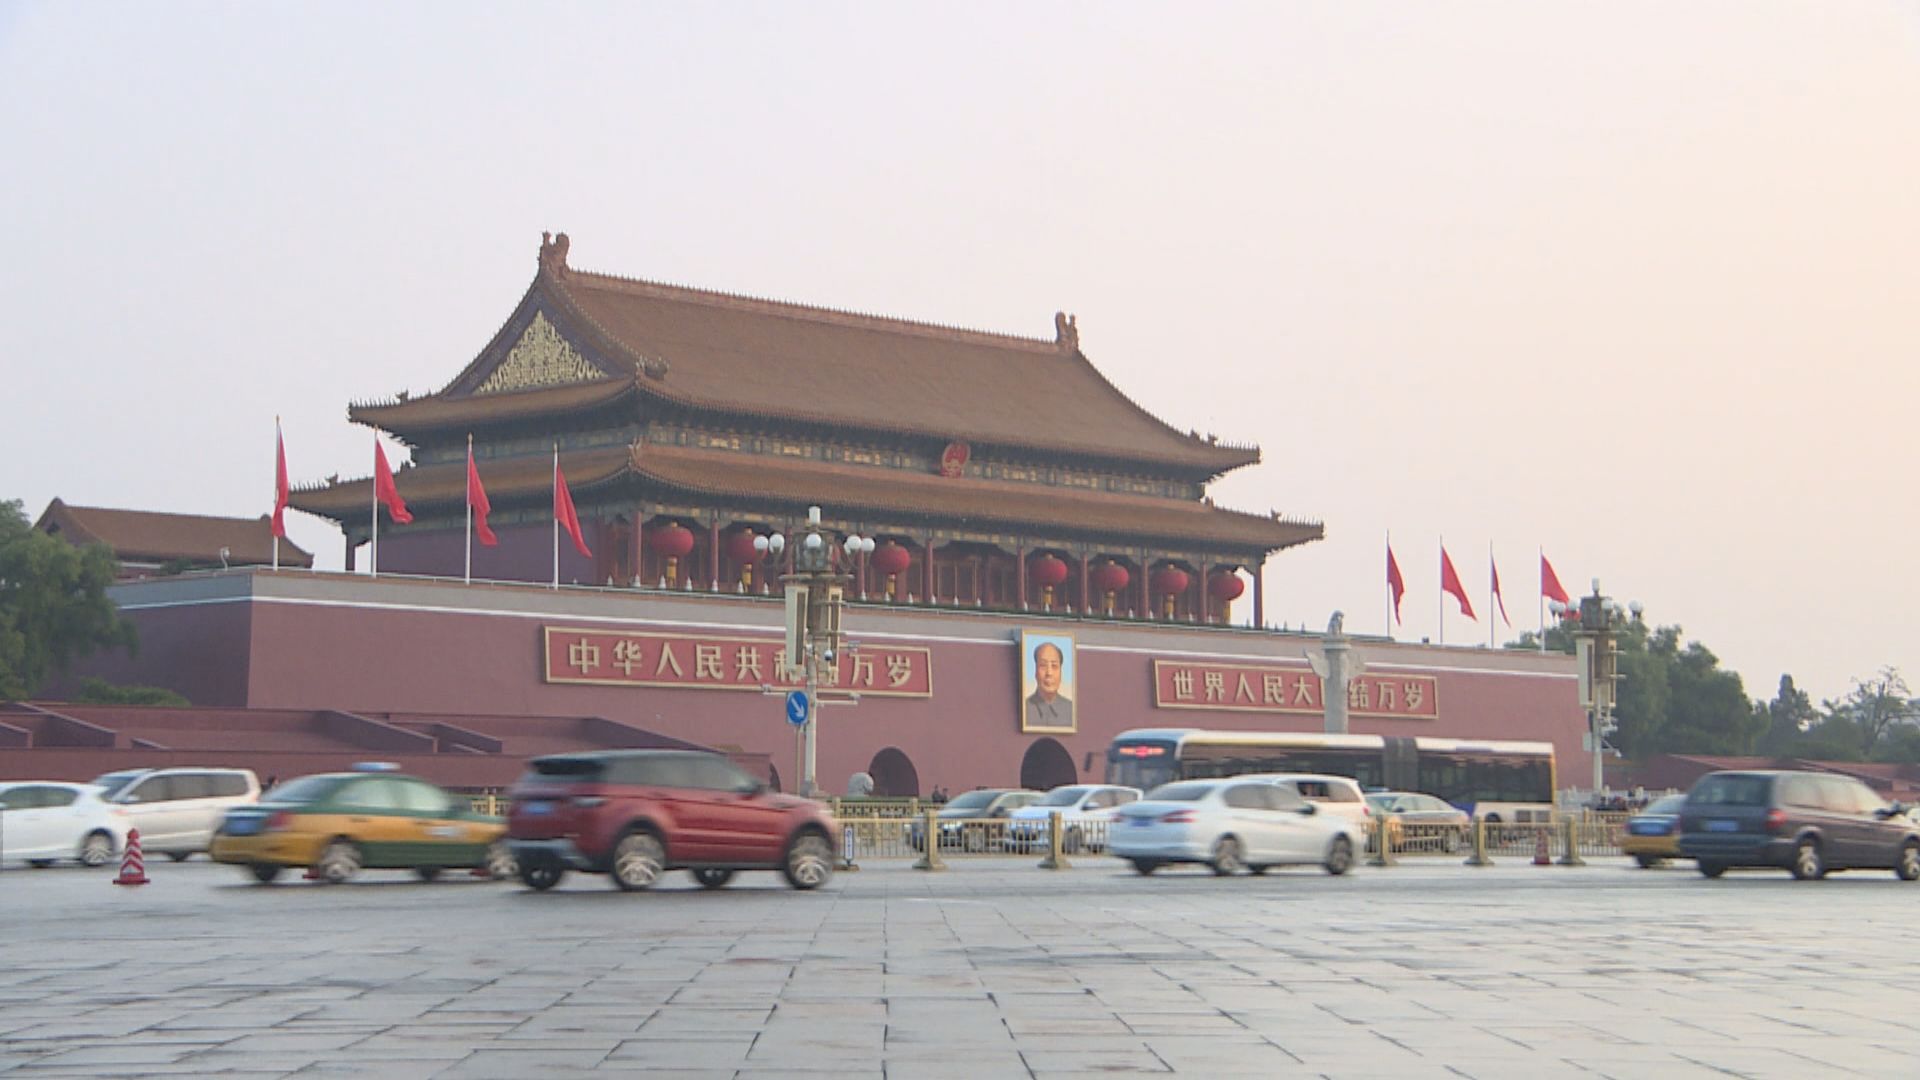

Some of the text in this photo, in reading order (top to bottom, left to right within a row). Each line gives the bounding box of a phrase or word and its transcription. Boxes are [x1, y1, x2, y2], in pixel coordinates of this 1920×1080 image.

[568, 638, 912, 687] 中华人民共和万岁
[1172, 669, 1424, 711] 世界人民大结万岁
